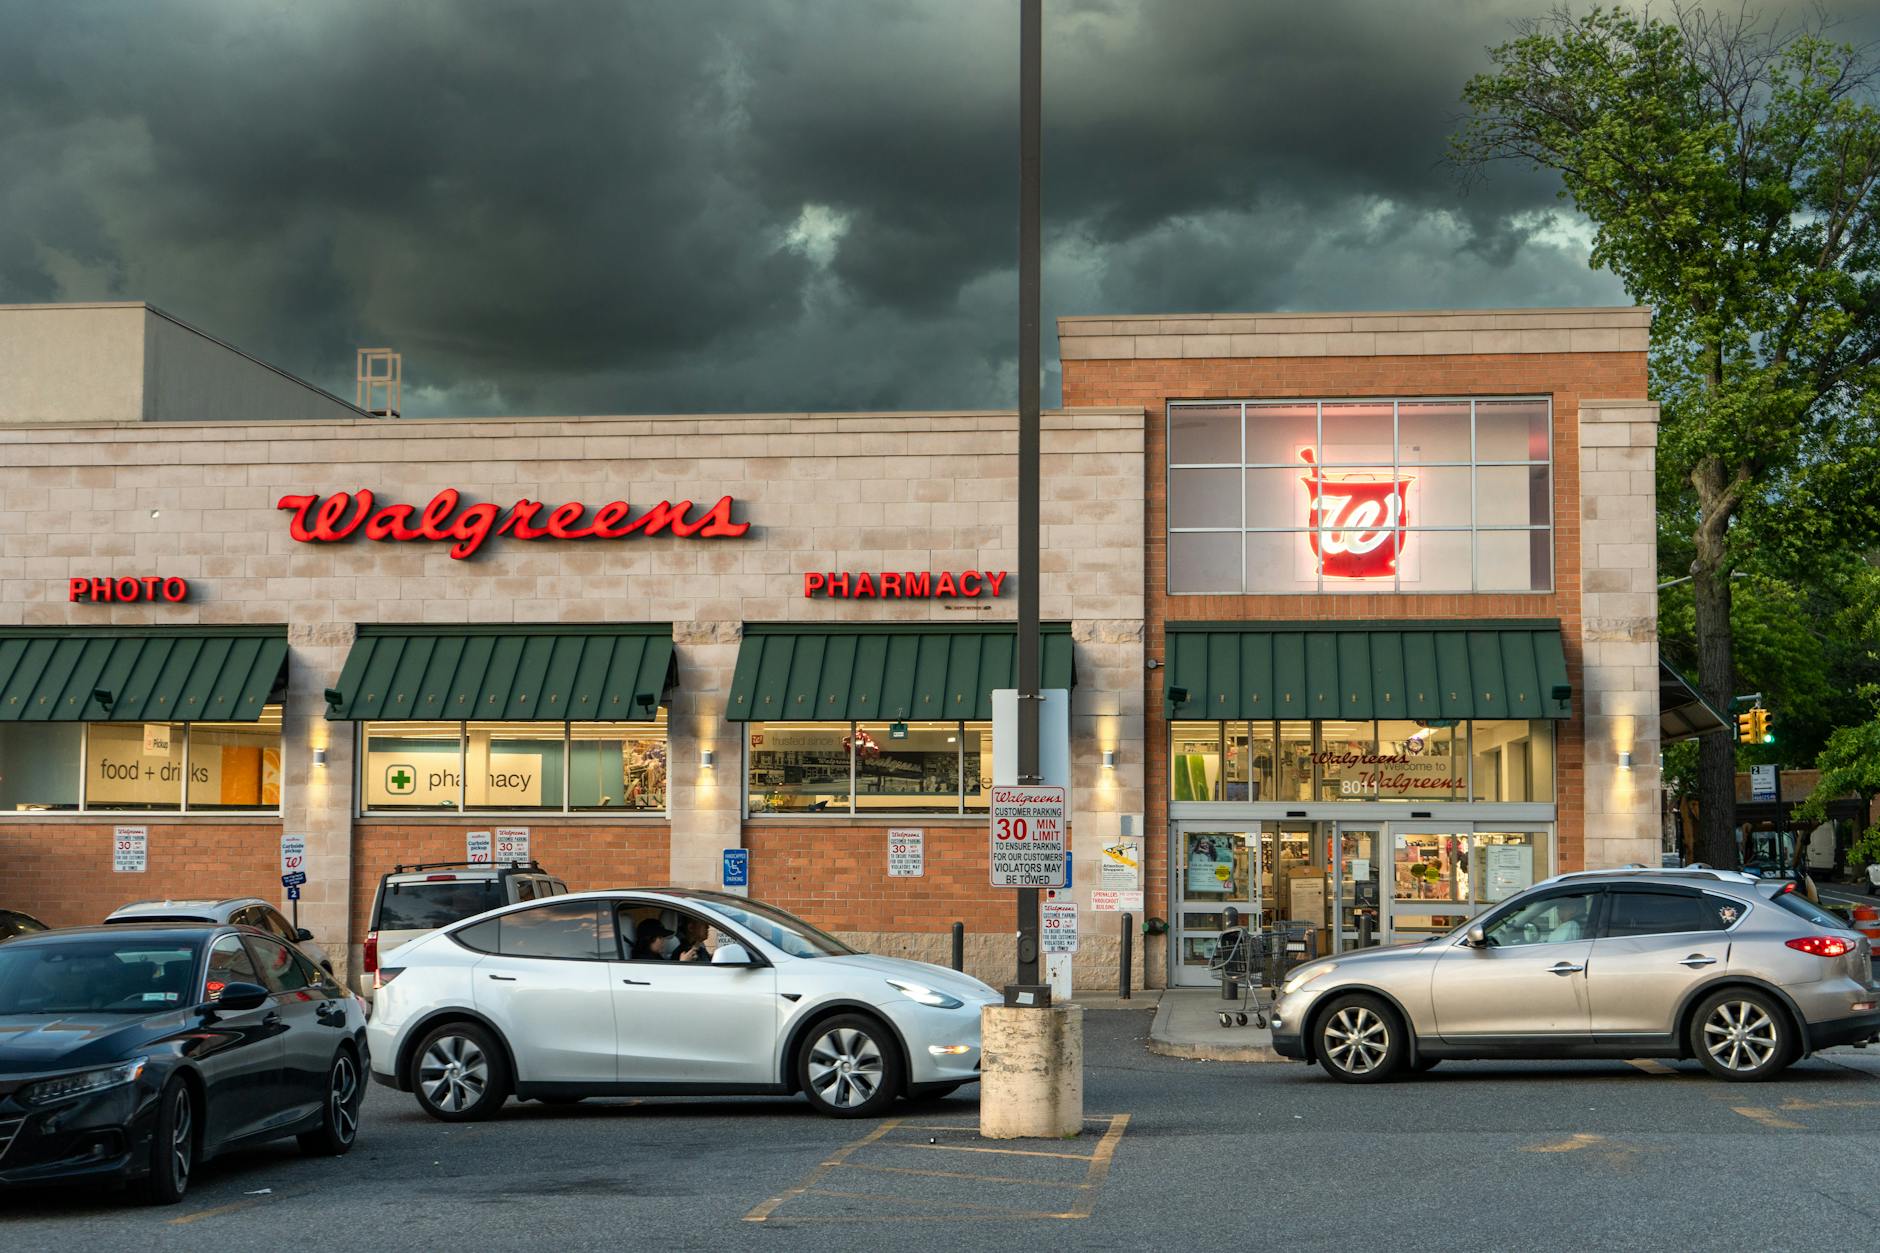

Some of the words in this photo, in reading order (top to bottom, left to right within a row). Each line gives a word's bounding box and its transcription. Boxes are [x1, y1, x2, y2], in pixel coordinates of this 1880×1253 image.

[277, 488, 751, 560] Walgreens
[69, 576, 188, 602] PHOTO
[804, 570, 1008, 599] PHARMACY
[153, 739, 168, 750] Pickup
[772, 735, 804, 746] trusted
[1309, 752, 1410, 768] Walgreens
[101, 758, 139, 780] food
[161, 762, 208, 783] driks
[1384, 762, 1433, 771] Welcome
[1435, 762, 1446, 771] to
[1341, 780, 1378, 794] 8011
[1359, 771, 1466, 794] Walgreens
[994, 791, 1062, 806] Walgreens
[994, 807, 1031, 816] CUSTOMER
[1032, 807, 1062, 816] PARKING
[1036, 819, 1056, 829] MIN
[996, 818, 1028, 841] 30
[1032, 831, 1061, 841] LIMIT
[118, 841, 131, 850] 30
[499, 842, 513, 851] 30
[892, 844, 906, 853] 30
[995, 842, 1004, 851] TO
[1005, 842, 1032, 851] ENSURE
[1032, 842, 1062, 851] PARKING
[994, 853, 1007, 861] FOR
[1008, 853, 1022, 861] OUR
[1023, 853, 1063, 861] CUSTOMERS
[994, 863, 1042, 873] VIOLATORS
[1044, 863, 1062, 873] MAY
[1006, 875, 1017, 885] BE
[1020, 875, 1050, 885] TOWED
[291, 890, 297, 898] 2
[1045, 919, 1060, 928] 30
